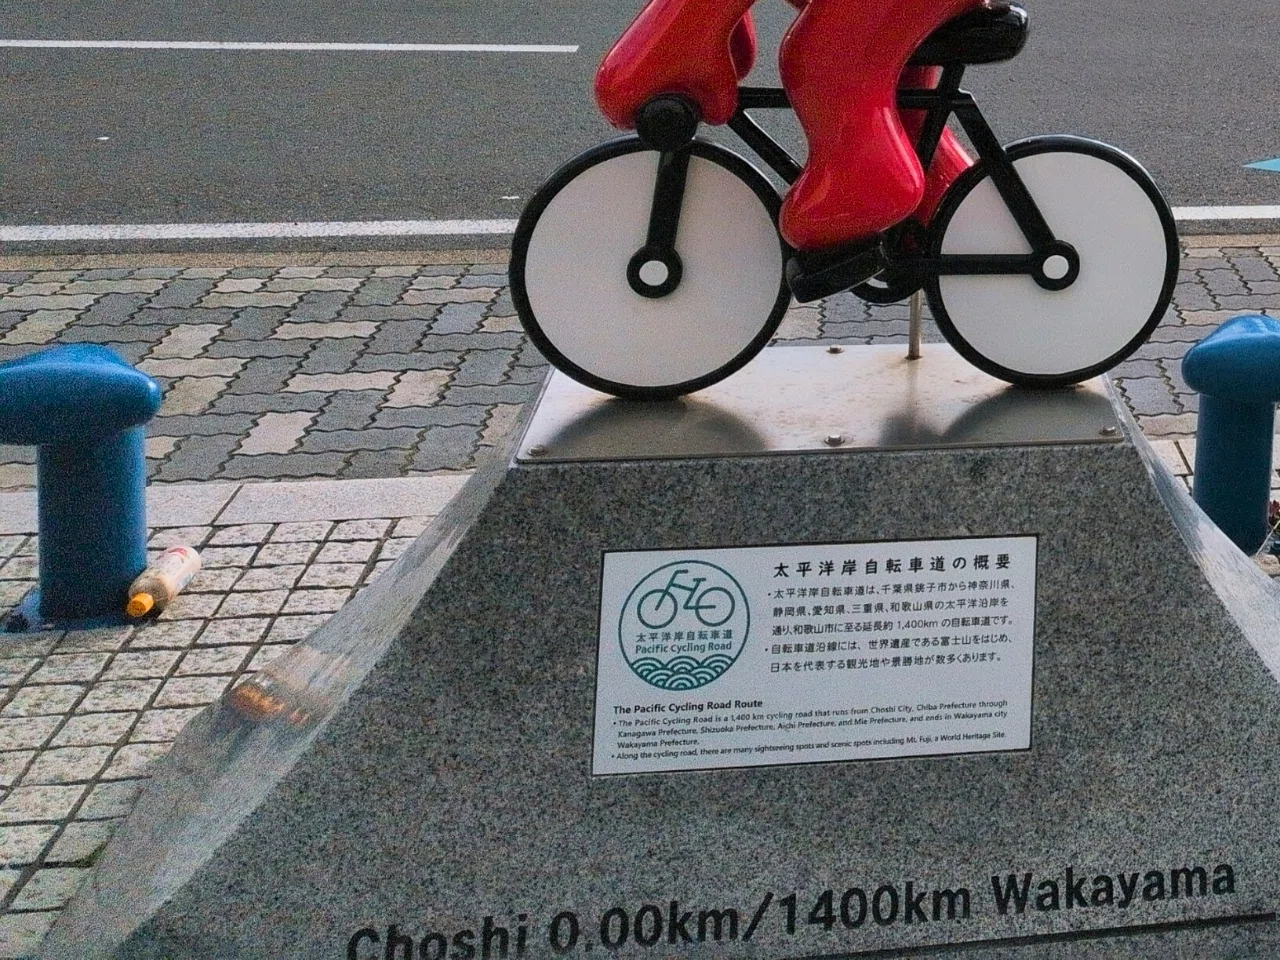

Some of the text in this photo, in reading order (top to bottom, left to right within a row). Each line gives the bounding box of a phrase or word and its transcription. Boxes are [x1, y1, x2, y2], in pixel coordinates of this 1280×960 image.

[773, 553, 1011, 578] 太平洋岸自転車道の概要
[635, 641, 732, 654] Pacific Cycling Road
[636, 629, 733, 642] 太平洋岸自転車道
[613, 699, 763, 714] The Pacific Cycling Road Route
[635, 718, 660, 726] Pacific
[662, 717, 691, 726] Cycling
[693, 716, 713, 724] Road
[766, 712, 792, 721] cycling
[795, 710, 813, 718] road
[815, 709, 830, 717] that
[851, 707, 868, 715] from
[871, 705, 895, 714] Choshi
[917, 703, 937, 711] Chiba
[939, 702, 976, 710] Prefecture
[979, 699, 1008, 708] through
[618, 730, 656, 739] Kanagawa
[700, 725, 734, 733] Shizuoka
[778, 722, 796, 730] Aichi
[838, 718, 852, 726] and
[854, 717, 867, 725] Mie
[910, 714, 924, 722] and
[925, 713, 942, 721] ends
[953, 711, 992, 720] Wakayama
[994, 710, 1007, 718] city
[616, 751, 638, 760] Along
[640, 750, 652, 758] the
[653, 750, 678, 759] cycling
[700, 747, 718, 755] there
[733, 746, 753, 754] many
[754, 743, 794, 753] sightseeing
[796, 742, 814, 751] spots
[815, 740, 829, 748] and
[853, 738, 872, 747] spots
[873, 736, 904, 746] including
[940, 733, 961, 741] World
[962, 732, 991, 741] Heritage
[617, 740, 657, 749] Wakayama
[346, 863, 1236, 960] Choshi 0.00km/1400km Wakayama
